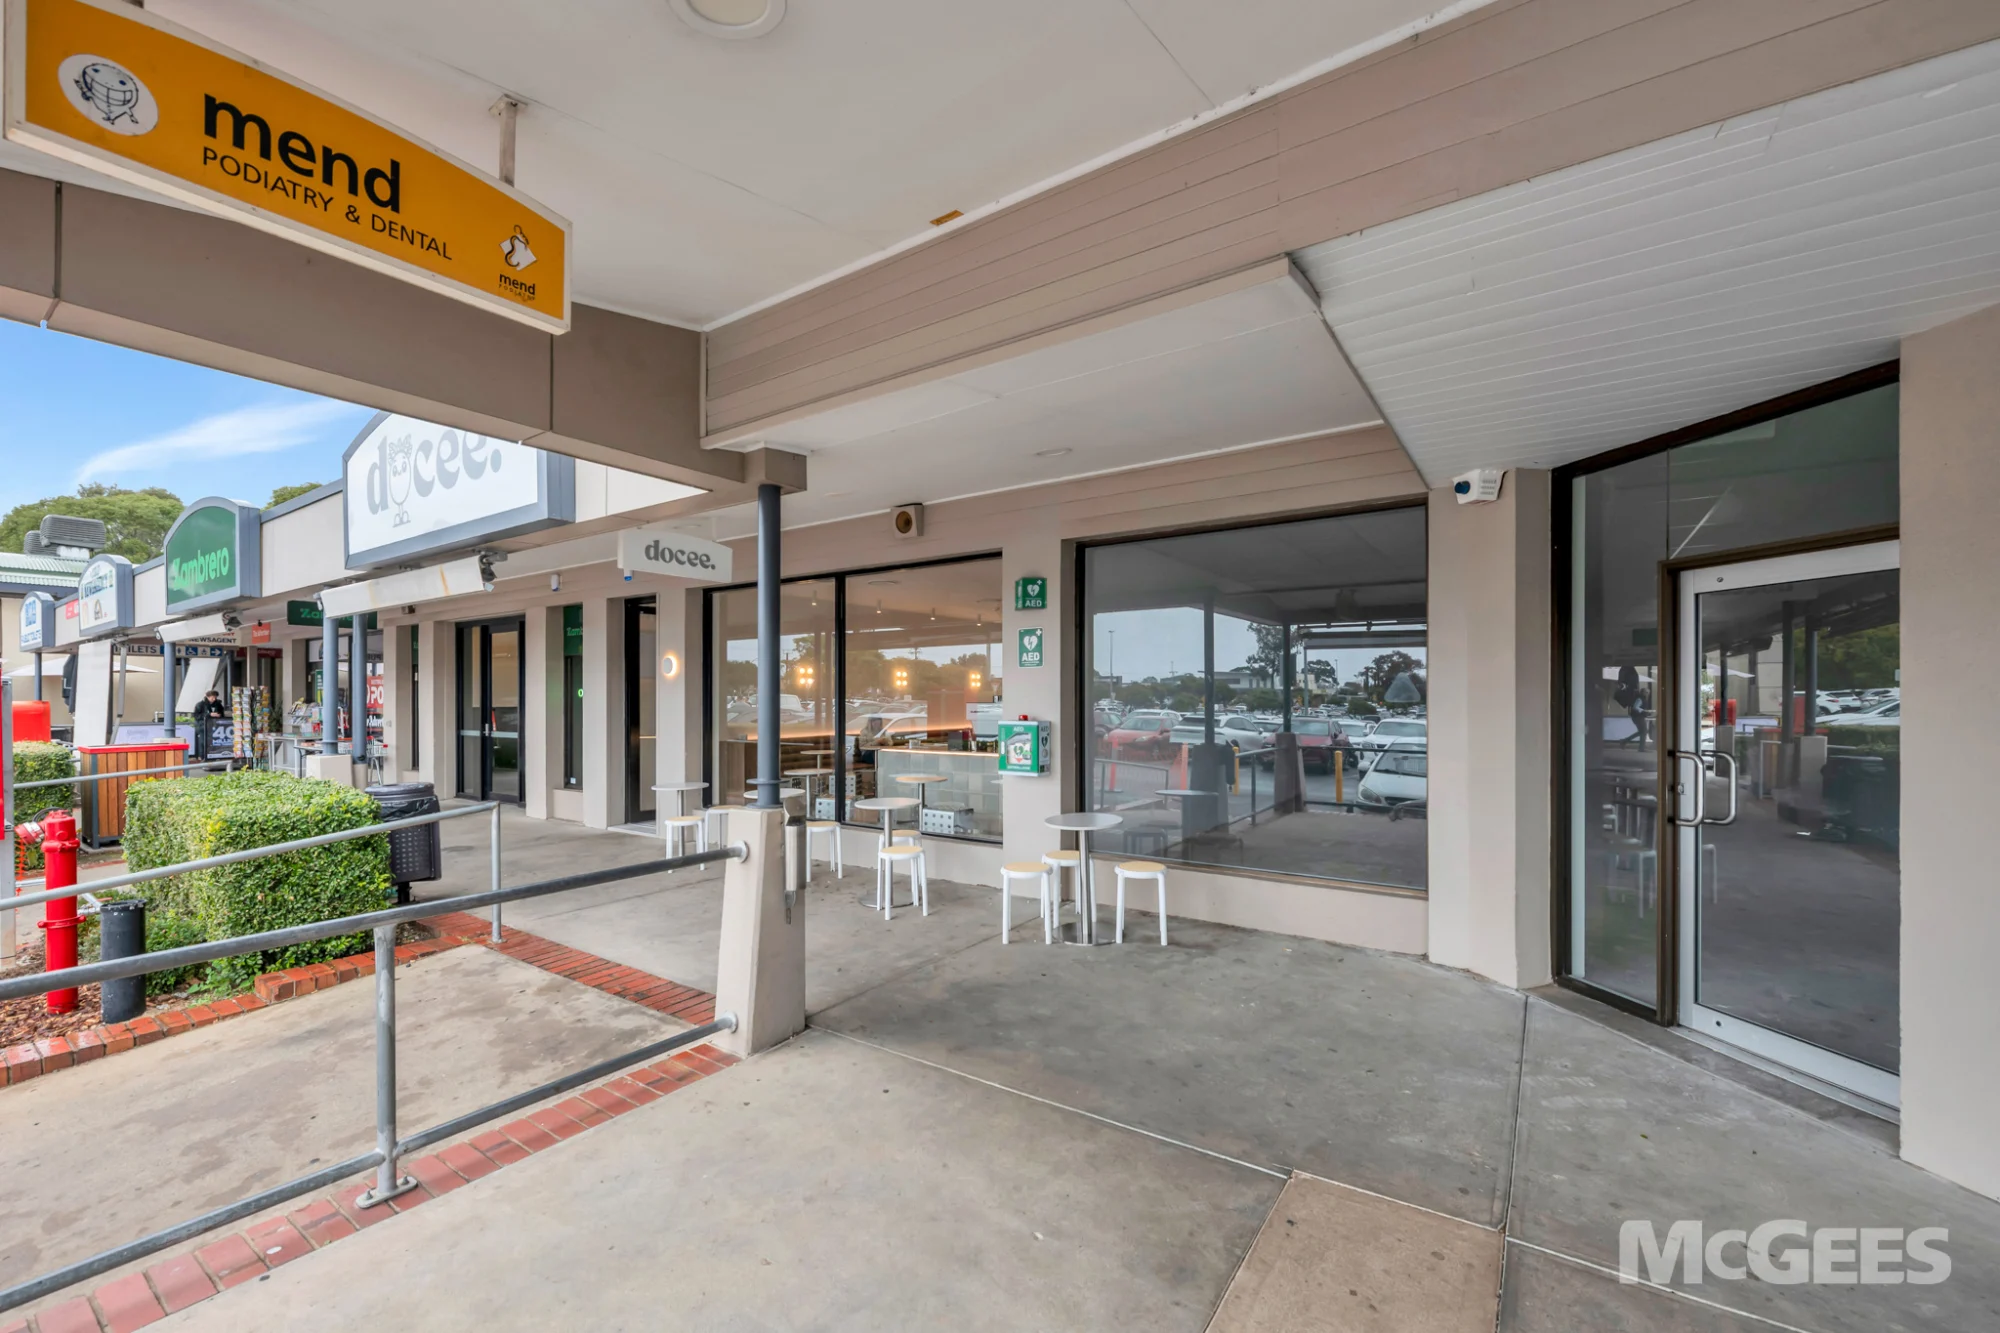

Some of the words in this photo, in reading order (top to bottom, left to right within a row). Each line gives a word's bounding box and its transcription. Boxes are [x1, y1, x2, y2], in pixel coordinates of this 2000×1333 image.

[203, 93, 401, 213] mend
[202, 146, 334, 212] PODIATRY
[345, 204, 361, 224] &
[371, 213, 453, 261] DENTAL
[499, 273, 536, 296] mend
[173, 547, 230, 591] Zambrero
[645, 539, 716, 570] docee.
[113, 643, 157, 654] TILETS
[1022, 652, 1040, 662] AED
